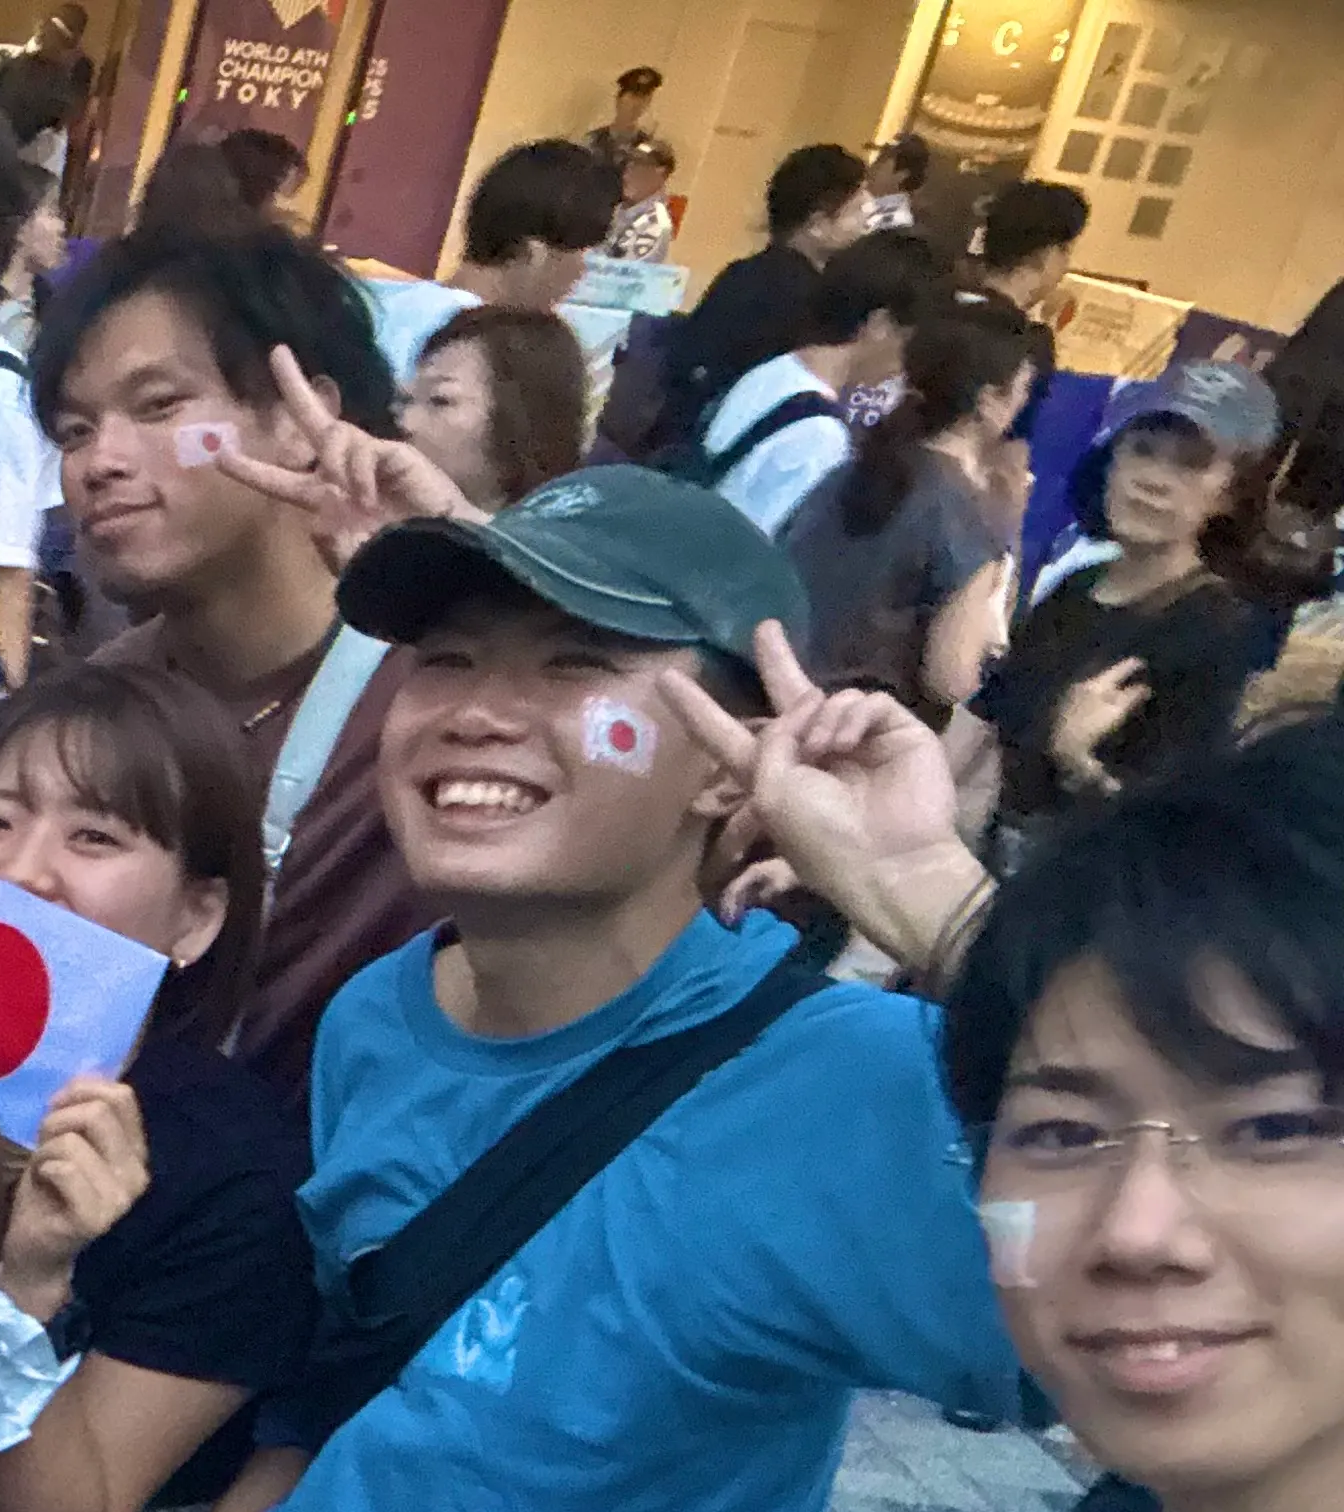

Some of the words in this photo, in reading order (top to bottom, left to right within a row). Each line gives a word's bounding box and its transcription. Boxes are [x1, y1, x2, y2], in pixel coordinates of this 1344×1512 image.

[225, 38, 290, 63] WORLD
[291, 47, 330, 67] ATH
[218, 58, 324, 88] CHAMPION
